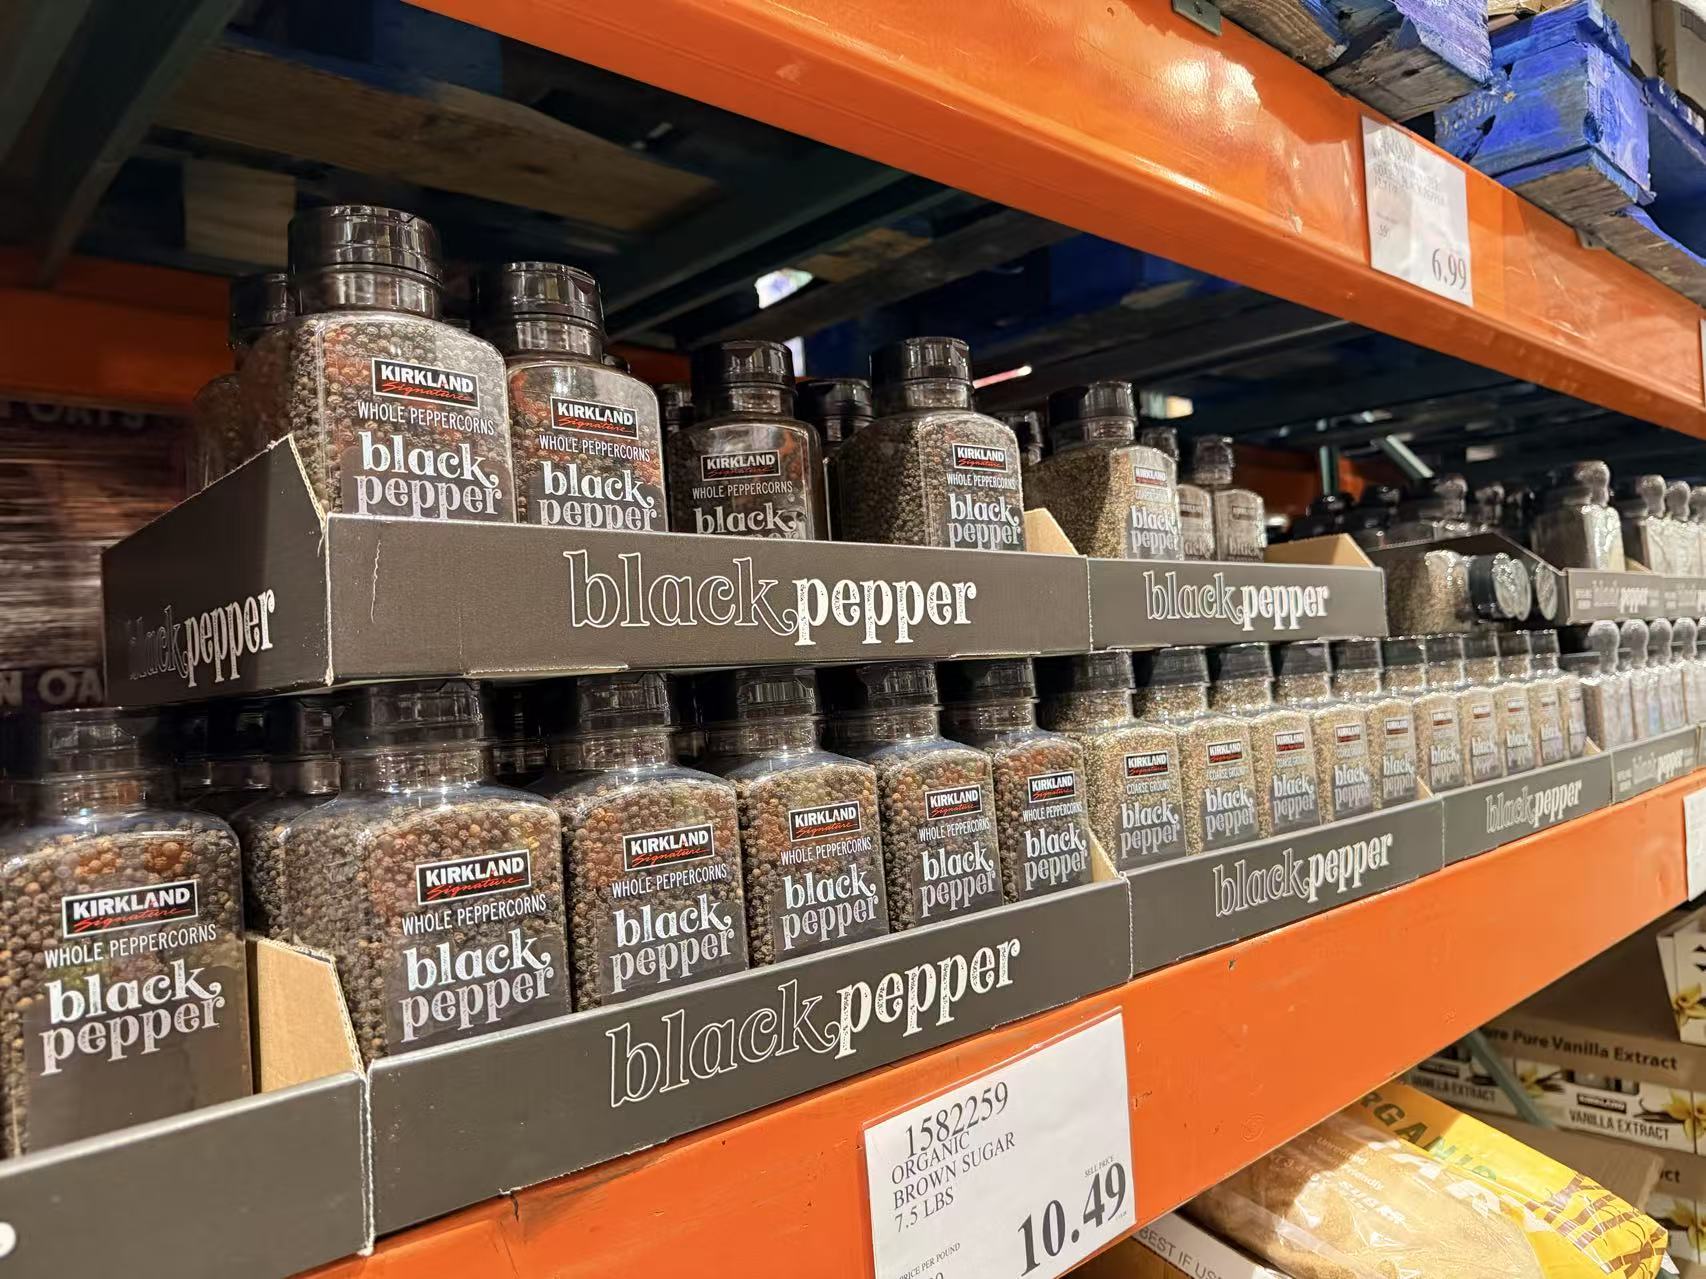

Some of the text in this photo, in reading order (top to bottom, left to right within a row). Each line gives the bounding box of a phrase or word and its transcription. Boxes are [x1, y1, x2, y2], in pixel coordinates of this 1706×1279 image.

[1431, 248, 1467, 290] 6.99
[381, 364, 474, 393] KIRKLAND
[382, 380, 474, 401] Signature
[357, 400, 495, 436] WHOLE PEPPERCORNS
[558, 402, 633, 426] KIRKLAND
[558, 416, 634, 434] Signature
[358, 430, 499, 489] black
[539, 434, 650, 462] WHOLE PEPPERCORNS
[707, 455, 775, 469] KIRKLAND
[957, 447, 1004, 461] KIRKLAND
[353, 475, 502, 520] pepper
[540, 461, 655, 508] black
[692, 481, 793, 499] WHOLE PEPPERCORNS
[947, 473, 1016, 490] WHOLE PEPPERCORNS
[537, 499, 658, 531] pepper
[693, 502, 797, 534] black
[948, 493, 1019, 526] black
[1131, 506, 1177, 534] black
[947, 522, 1020, 550] pepper
[563, 549, 976, 645] black pepper
[1143, 570, 1330, 631] black pepper
[184, 588, 275, 688] pepper
[1127, 754, 1167, 768] KIRKLAND
[1209, 743, 1241, 756] KIRKLAND
[1383, 753, 1415, 776] black
[1031, 775, 1073, 792] KIRKLAND
[1126, 779, 1171, 795] COARSE GROUND
[1273, 772, 1314, 798] black
[1334, 762, 1369, 786] black
[930, 790, 979, 808] KIRKLAND
[1022, 801, 1083, 823] WHOLE PEPPERCORNS
[1120, 797, 1179, 829] black
[1204, 783, 1253, 813] black
[1273, 792, 1315, 824] pepper
[1485, 786, 1536, 833] black
[1533, 780, 1583, 828] pepper
[795, 807, 857, 828] KIRKLAND
[796, 822, 857, 837] Signature
[918, 817, 990, 842] WHOLE PEPPERCORNS
[1204, 806, 1255, 841] pepper
[631, 830, 709, 856] KIRKLAND
[632, 848, 707, 865] Signature
[780, 837, 872, 866] WHOLE PEPPERCORNS
[1024, 822, 1087, 858] black
[1120, 823, 1180, 859] pepper
[426, 857, 524, 887] KIRKLAND
[921, 840, 995, 882] black
[1023, 850, 1089, 891] pepper
[1214, 832, 1394, 918] black pepper
[427, 876, 525, 900] Signature
[612, 864, 727, 899] WHOLE PEPPERCORNS
[782, 863, 877, 910] black
[918, 869, 996, 918] pepper
[73, 887, 191, 920] KIRKLAND
[402, 894, 547, 936] WHOLE PEPPERCORNS
[73, 908, 191, 933] Signature
[613, 894, 732, 948] black
[779, 893, 879, 950] pepper
[44, 924, 217, 968] WHOLE PEPPERCORNS
[403, 928, 551, 991] black
[609, 928, 735, 994] pepper
[45, 958, 222, 1025] black
[399, 966, 554, 1043] pepper
[39, 997, 225, 1076] pepper
[605, 939, 1020, 1108] black pepper
[1485, 1027, 1678, 1072] ure Pure Vanilla Extract
[1452, 1080, 1496, 1103] EXTRACT
[905, 1081, 1008, 1159] 1582259
[1569, 1108, 1670, 1141] VANILLA EXTRACT
[891, 1131, 970, 1185] ORGANIC
[893, 1131, 1015, 1211] BROWN SUGAR
[895, 1186, 954, 1233] 7.5 LBS
[1017, 1163, 1127, 1277] 10.49
[921, 1256, 935, 1271] PER
[936, 1242, 961, 1263] POUND
[1140, 1227, 1224, 1279] BEST IF US
